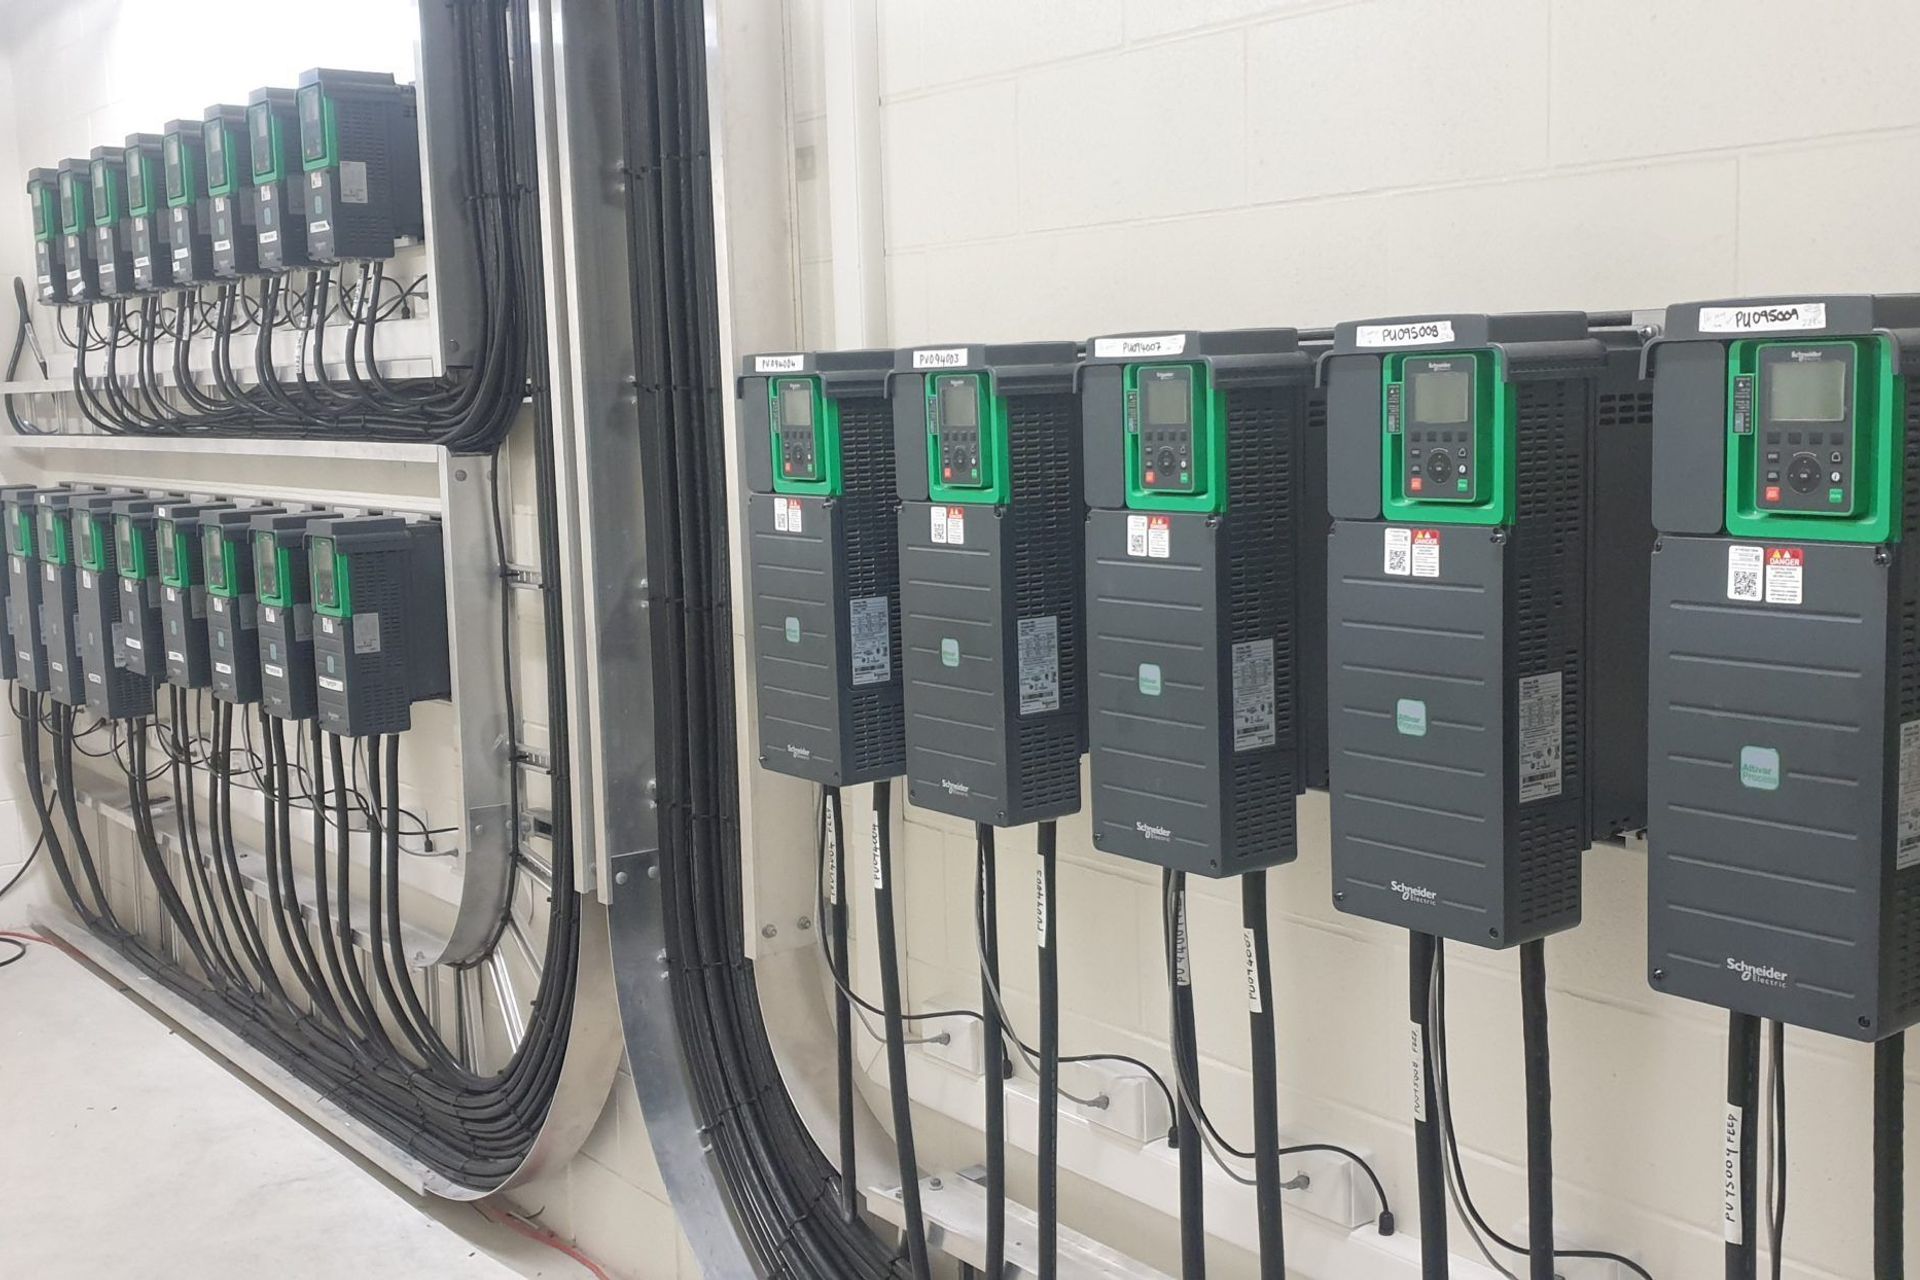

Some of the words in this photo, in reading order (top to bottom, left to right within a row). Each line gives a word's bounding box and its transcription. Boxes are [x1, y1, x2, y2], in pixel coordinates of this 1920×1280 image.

[1736, 308, 1798, 328] PU095009
[1382, 325, 1439, 341] PU095008
[1769, 557, 1800, 566] DANGER
[1391, 880, 1437, 900] Schneider
[1726, 957, 1788, 981] Schneider
